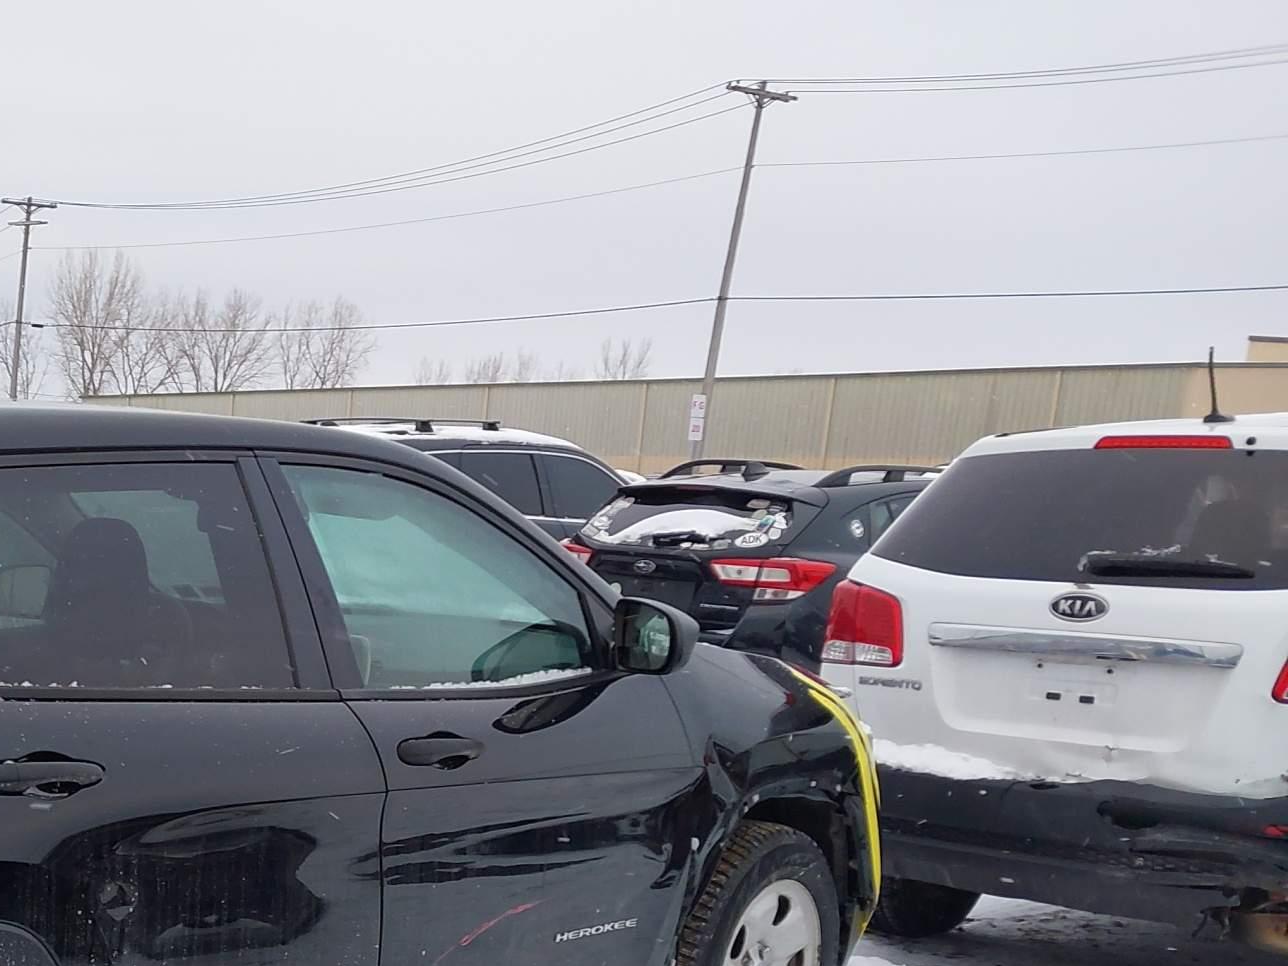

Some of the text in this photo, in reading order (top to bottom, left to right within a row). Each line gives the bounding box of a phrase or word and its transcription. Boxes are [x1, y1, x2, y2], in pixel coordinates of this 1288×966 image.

[741, 534, 763, 545] ADK
[1058, 599, 1097, 616] KIA
[555, 918, 639, 943] HEROKEE
